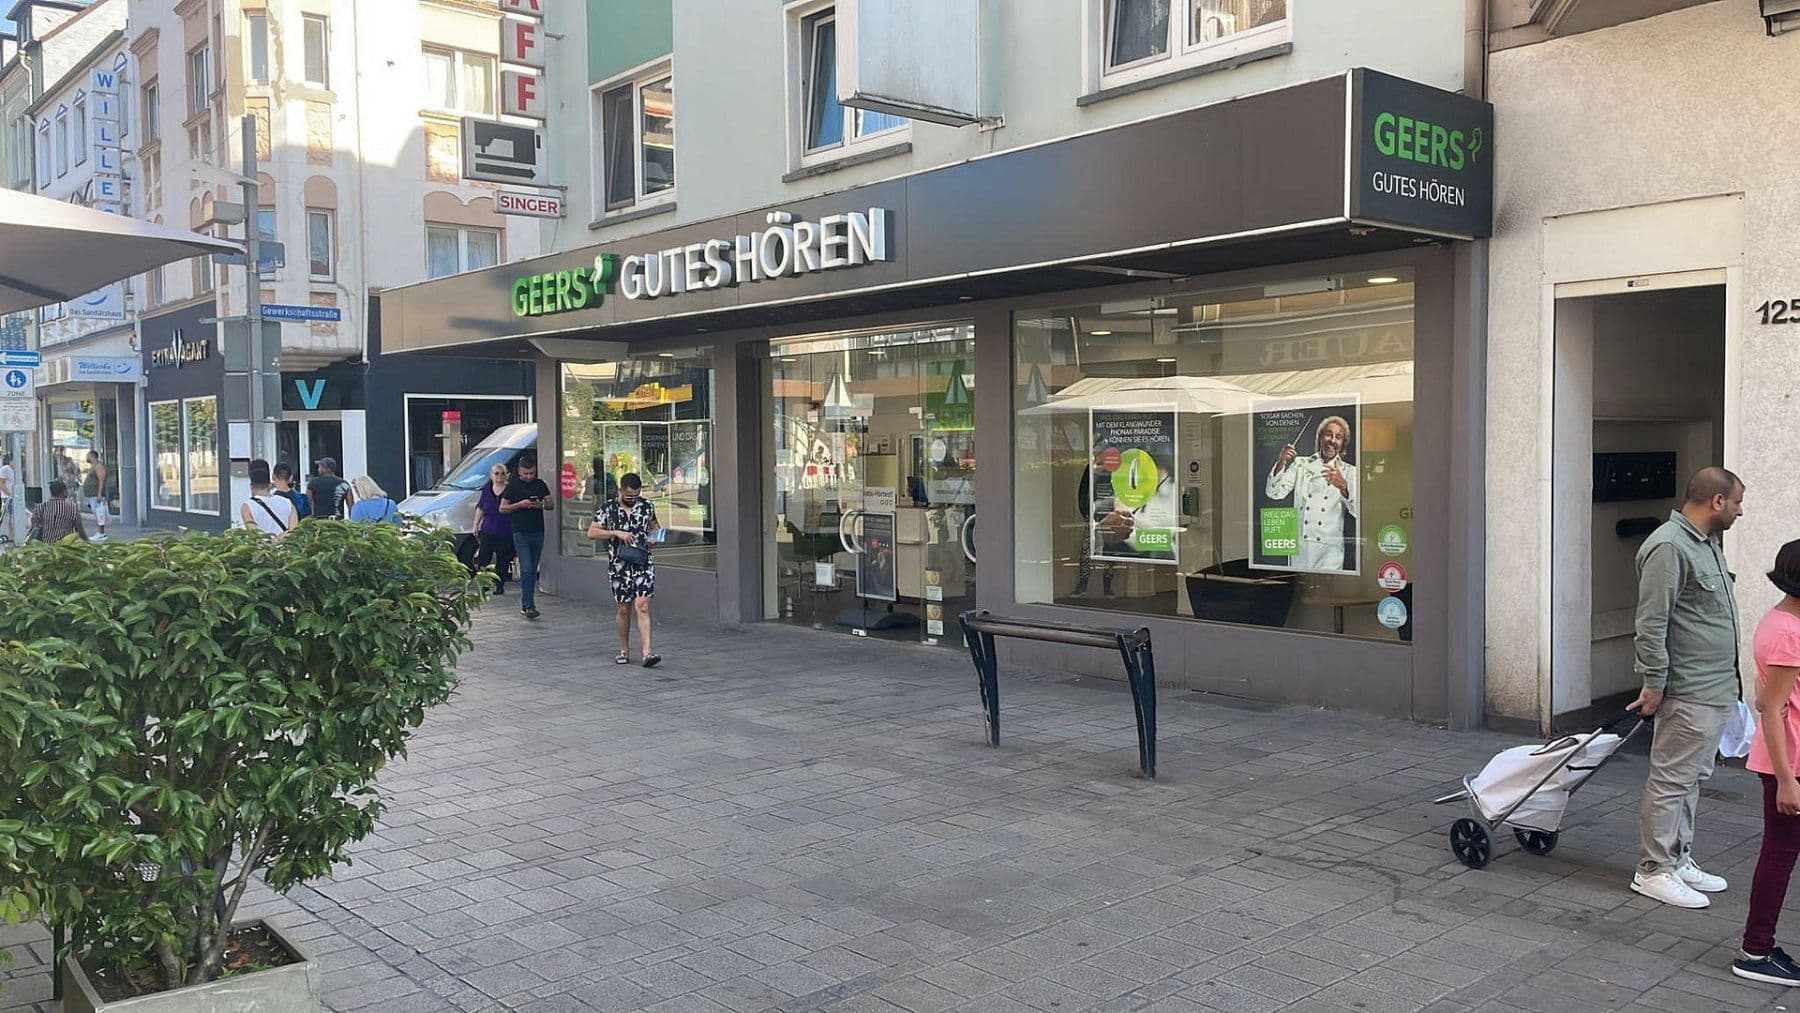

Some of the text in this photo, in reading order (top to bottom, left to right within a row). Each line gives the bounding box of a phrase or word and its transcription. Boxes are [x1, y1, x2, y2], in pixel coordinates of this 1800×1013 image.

[510, 0, 540, 112] FF
[97, 73, 114, 213] WILLE
[1374, 112, 1465, 170] GEERS
[1373, 171, 1465, 206] GUTES HÖREN
[500, 195, 559, 214] SINGER
[512, 207, 886, 317] GEERS GUTES HÖREN
[262, 304, 338, 319] Gewerkschaftsstraße
[1755, 299, 1800, 325] 125
[294, 379, 327, 410] V
[1139, 534, 1168, 544] GEERS
[1264, 539, 1297, 549] GEERS
